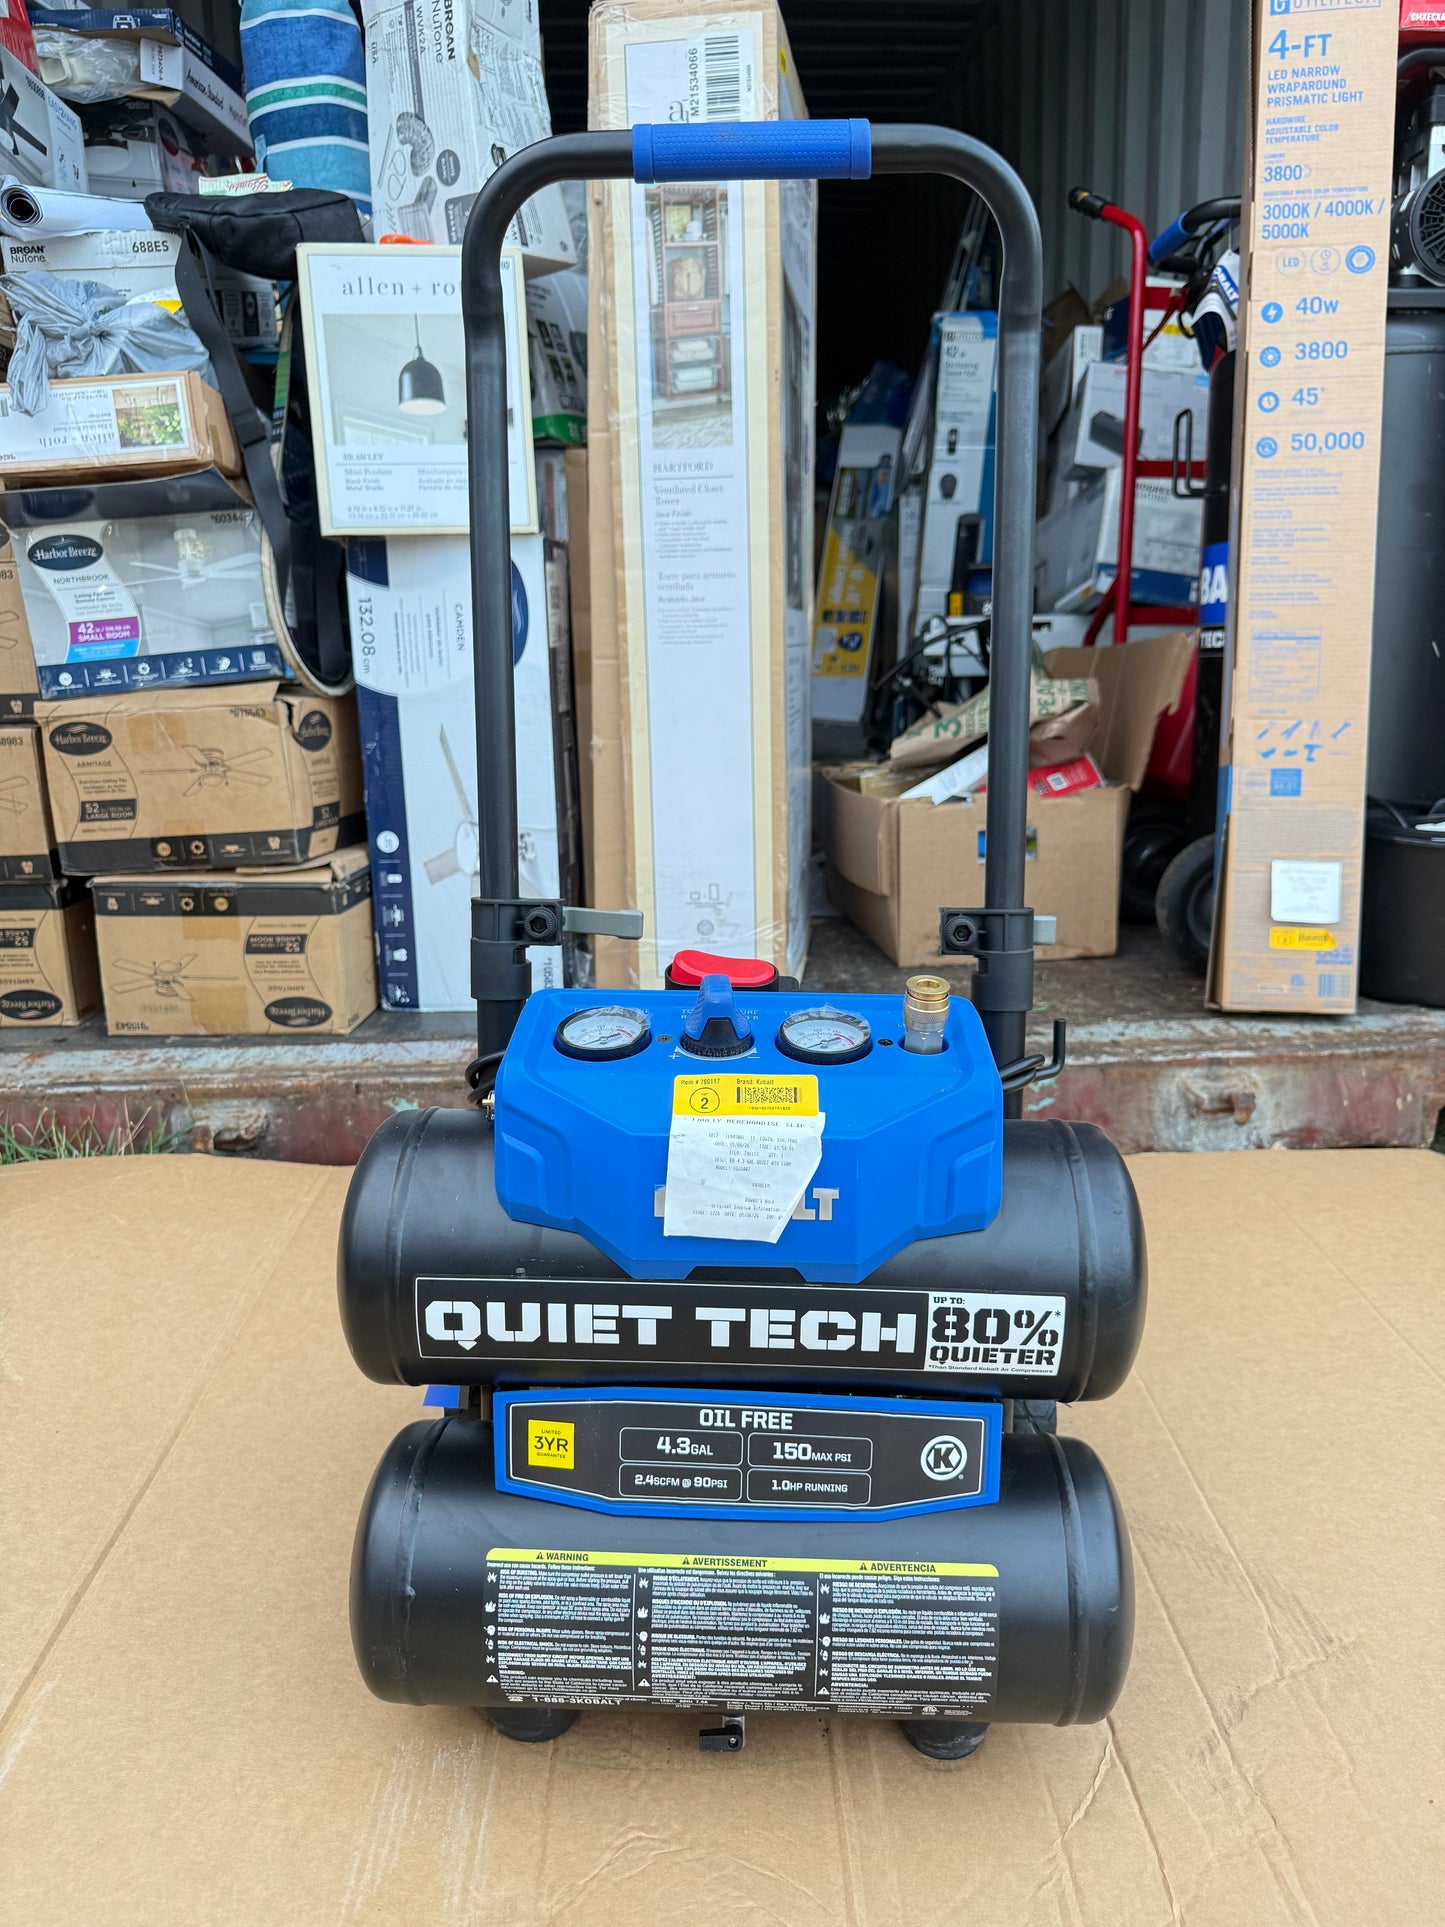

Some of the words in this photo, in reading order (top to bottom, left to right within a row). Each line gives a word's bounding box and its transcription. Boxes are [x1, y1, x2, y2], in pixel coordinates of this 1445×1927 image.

[416, 5, 426, 55] WVK2A
[431, 0, 443, 64] NuTone
[444, 0, 456, 61] BROAN
[1268, 29, 1332, 60] 4-FT
[1268, 69, 1288, 81] LED
[1292, 65, 1341, 79] NARROW
[688, 48, 701, 117] M21534066
[1267, 78, 1347, 94] WRAPAROUND
[1267, 93, 1328, 108] PRISMATIC
[1332, 91, 1364, 104] LIGHT
[1264, 165, 1303, 182] 3800
[1262, 202, 1310, 221] 3000K
[1324, 199, 1374, 217] 4000K
[1262, 222, 1309, 240] 5000K
[10, 245, 45, 255] BROAN
[132, 240, 169, 253] 688ES
[11, 254, 46, 264] NuTone
[342, 276, 405, 297] allen
[1294, 341, 1348, 361] 3800
[1290, 432, 1365, 453] 50,000
[34, 547, 68, 561] Harbor
[68, 545, 98, 558] Breeze
[77, 623, 95, 634] 42
[358, 596, 376, 656] 132.08
[454, 603, 466, 652] CAMDEN
[700, 1097, 709, 1110] 2
[933, 1296, 948, 1304] UP
[949, 1297, 966, 1305] TO:
[424, 1299, 673, 1351] QUIET
[695, 1306, 917, 1354] TECH
[930, 1345, 1056, 1366] QUIETER
[699, 1409, 736, 1428] OIL
[741, 1410, 793, 1431] FREE
[541, 1428, 562, 1436] LIMITED
[533, 1435, 569, 1453] 3YR
[536, 1451, 566, 1459] GUARANTEE
[804, 1483, 849, 1493] RUNNING
[546, 1552, 589, 1562] WARNING
[692, 1557, 768, 1568] AVERTISSEMENT
[870, 1563, 937, 1573] ADVERTENCIA
[532, 1697, 622, 1706] 1-888-3KOBALT
